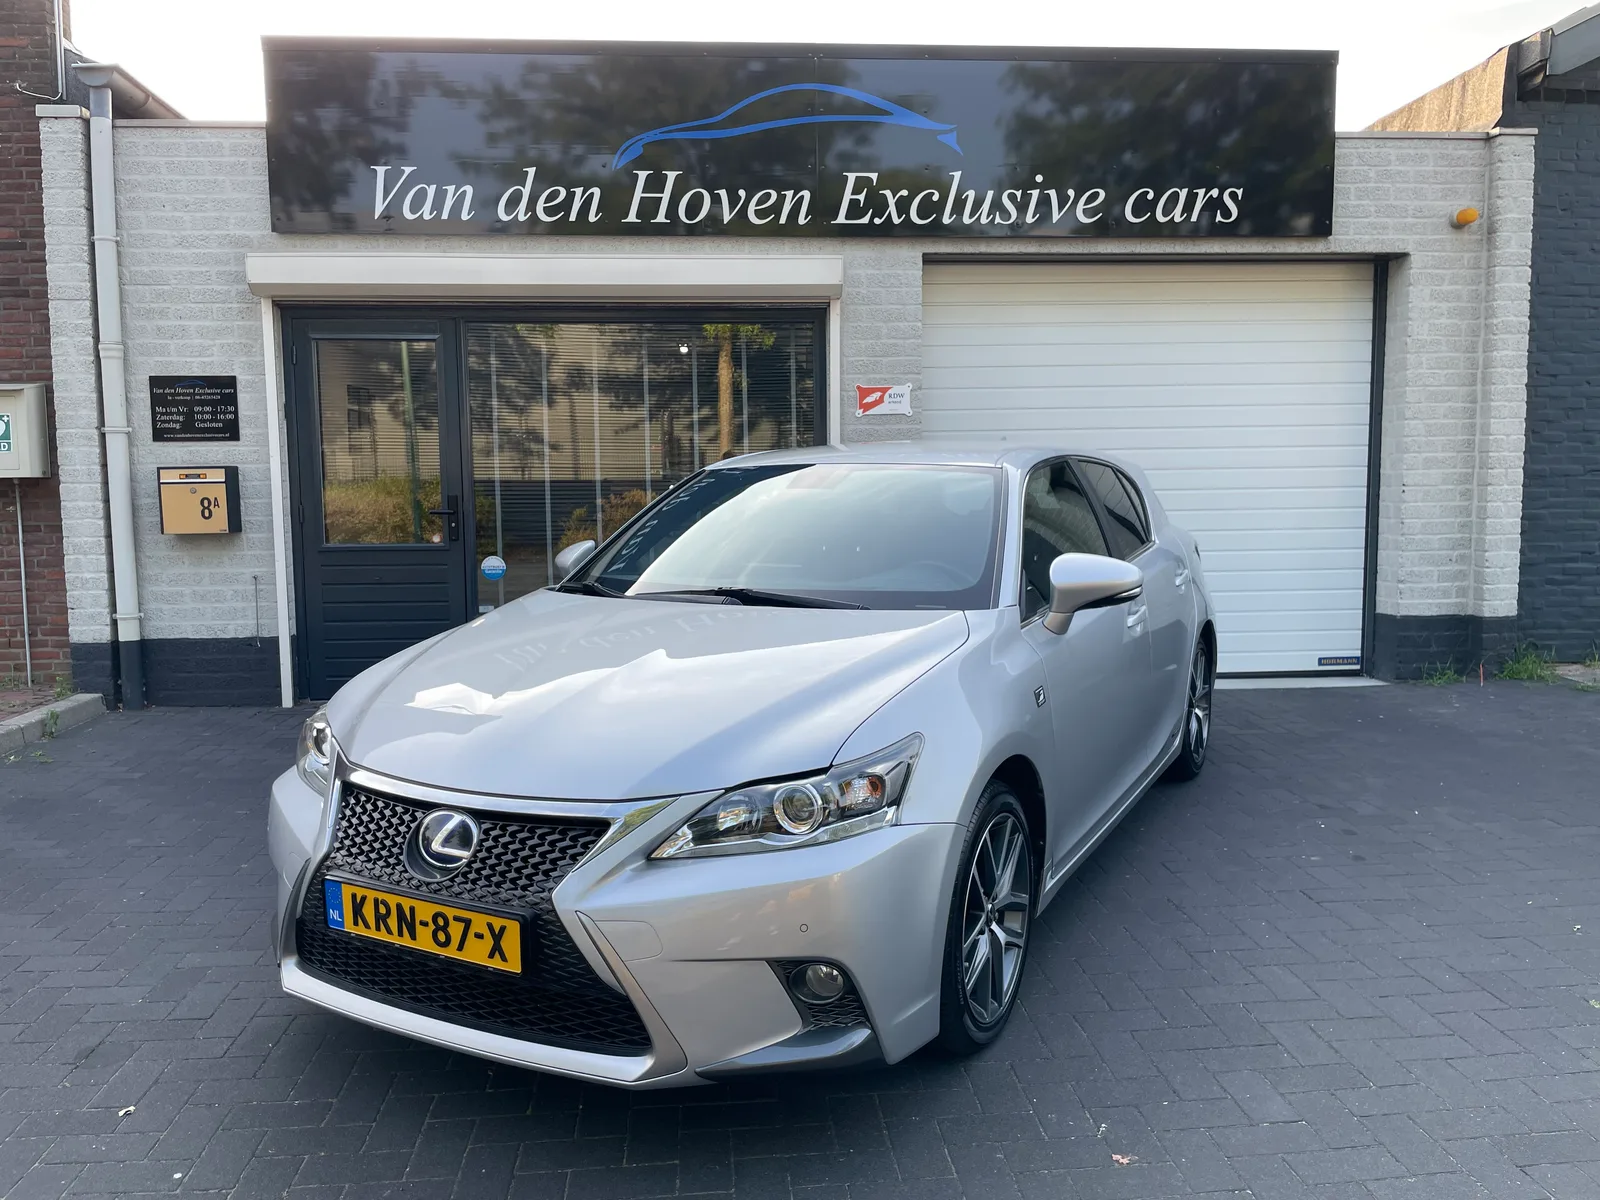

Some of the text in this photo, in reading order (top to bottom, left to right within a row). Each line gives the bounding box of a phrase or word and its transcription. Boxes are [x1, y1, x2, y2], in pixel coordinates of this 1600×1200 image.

[370, 166, 1244, 225] Van den Hoven Exclusive cars
[156, 414, 186, 422] Zaterdag:
[156, 421, 182, 429] Zondag:
[329, 909, 342, 922] NL
[350, 891, 509, 963] KRN-87-X
